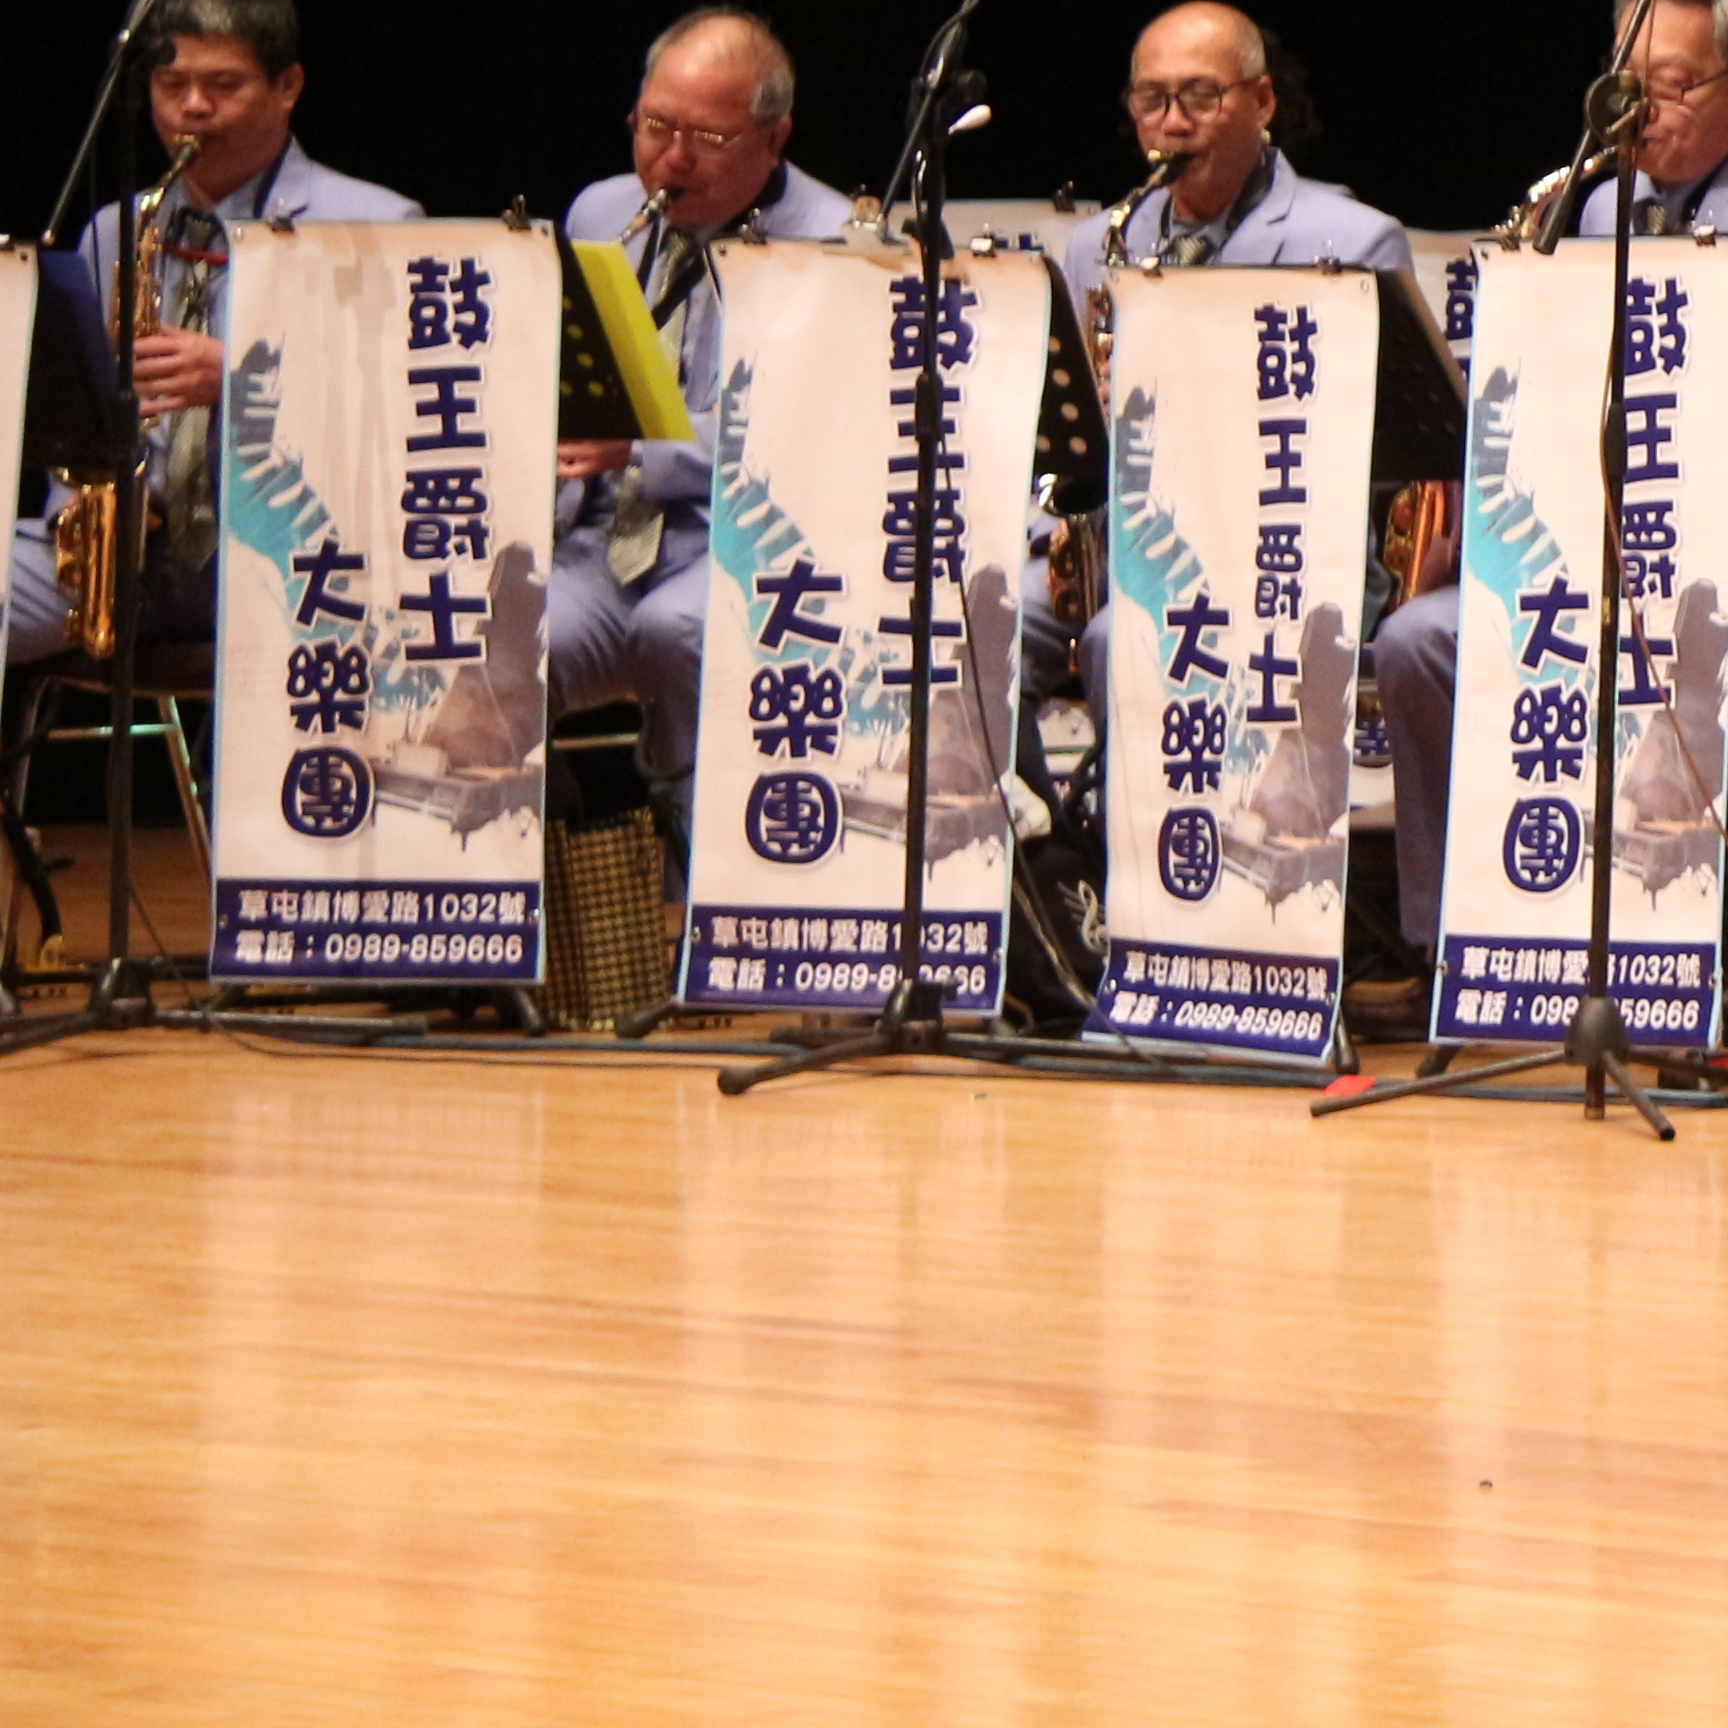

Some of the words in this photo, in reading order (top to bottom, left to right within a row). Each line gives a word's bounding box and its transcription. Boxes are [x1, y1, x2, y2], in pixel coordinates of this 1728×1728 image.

[399, 255, 493, 663] 鼓王爵士
[878, 276, 979, 688] 鼓王爵士
[1247, 303, 1320, 727] 鼓王爵士
[1620, 278, 1690, 707] 鼓王爵士
[282, 538, 374, 838] 大樂團
[745, 560, 845, 866] 大樂團
[1158, 594, 1232, 904] 大樂團
[1503, 578, 1591, 894] 大樂團
[238, 889, 527, 924] 草屯鎮博愛路1032號
[712, 915, 989, 955] 草屯鎮博愛路132號
[1460, 945, 1700, 989] 草屯鎮博愛1032號
